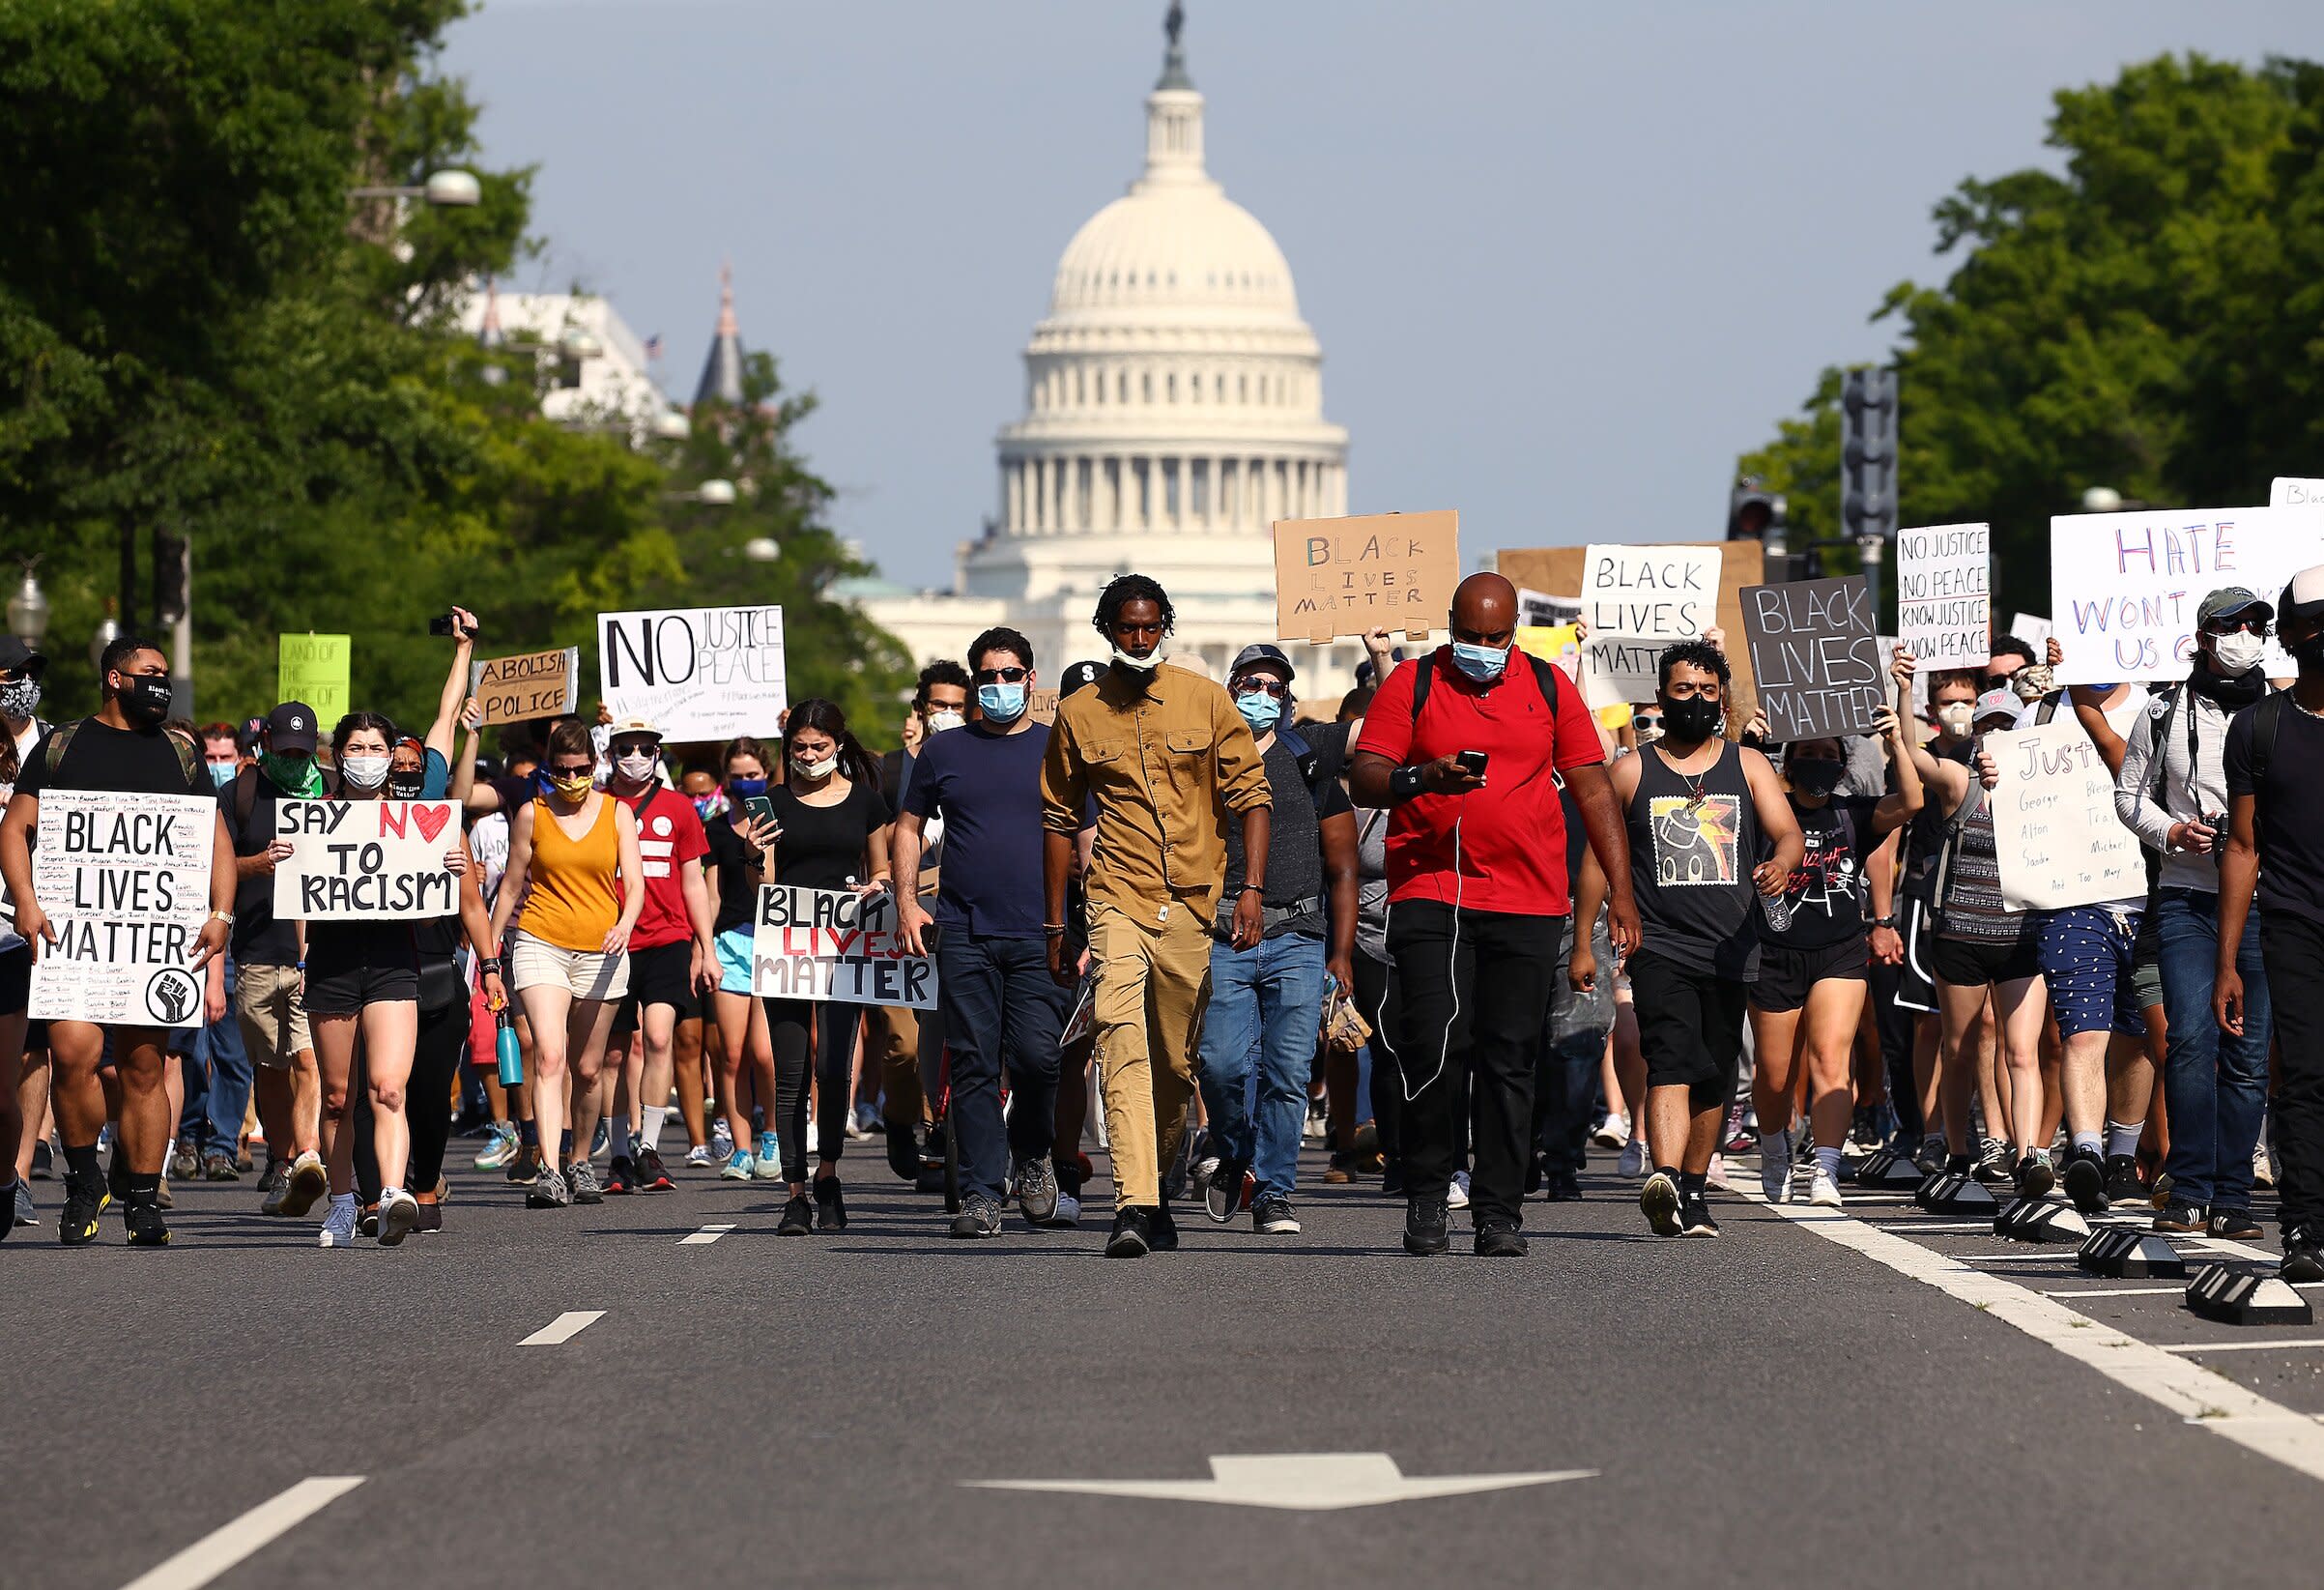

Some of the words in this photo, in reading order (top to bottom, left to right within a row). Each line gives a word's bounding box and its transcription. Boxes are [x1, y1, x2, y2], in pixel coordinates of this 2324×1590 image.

[1307, 535, 1423, 566] BLACK
[1902, 535, 1927, 561] NO
[1933, 532, 1986, 557] JUSTICE
[2115, 522, 2236, 576] HATE
[1311, 570, 1418, 592] LIVES
[1596, 558, 1702, 591] BLACK
[1904, 573, 1927, 599] NO
[1933, 566, 1987, 596] PEACE
[1294, 589, 1422, 615] MATTER
[1756, 584, 1871, 634] BLACK
[1902, 603, 1934, 627] KNOW
[1937, 599, 1987, 626] JUSTICE
[1594, 601, 1697, 637] LIVES
[318, 642, 338, 663] OF
[607, 616, 695, 687] NO
[696, 609, 781, 650] JUSTICE
[1592, 644, 1660, 675] MATT
[1940, 630, 1989, 656] PEACE
[2115, 637, 2160, 670] US
[480, 652, 565, 685] ABOLISH
[698, 647, 783, 685] PEACE
[1081, 665, 1095, 681] S
[1753, 636, 1877, 687] LIVES
[486, 688, 564, 721] POLICE
[278, 800, 352, 835] SAY
[2020, 790, 2058, 812] George
[65, 812, 176, 855] BLACK
[2022, 824, 2049, 840] Alton
[2086, 806, 2116, 827] Tray
[328, 842, 384, 875] TO
[2090, 836, 2127, 854] Michael
[75, 868, 174, 911] LIVES
[301, 872, 451, 912] RACISM
[2079, 873, 2092, 882] Too
[761, 887, 890, 931] BLACK
[45, 919, 186, 965] MATTER
[783, 927, 904, 959] LIVES
[755, 954, 931, 1004] MATTER
